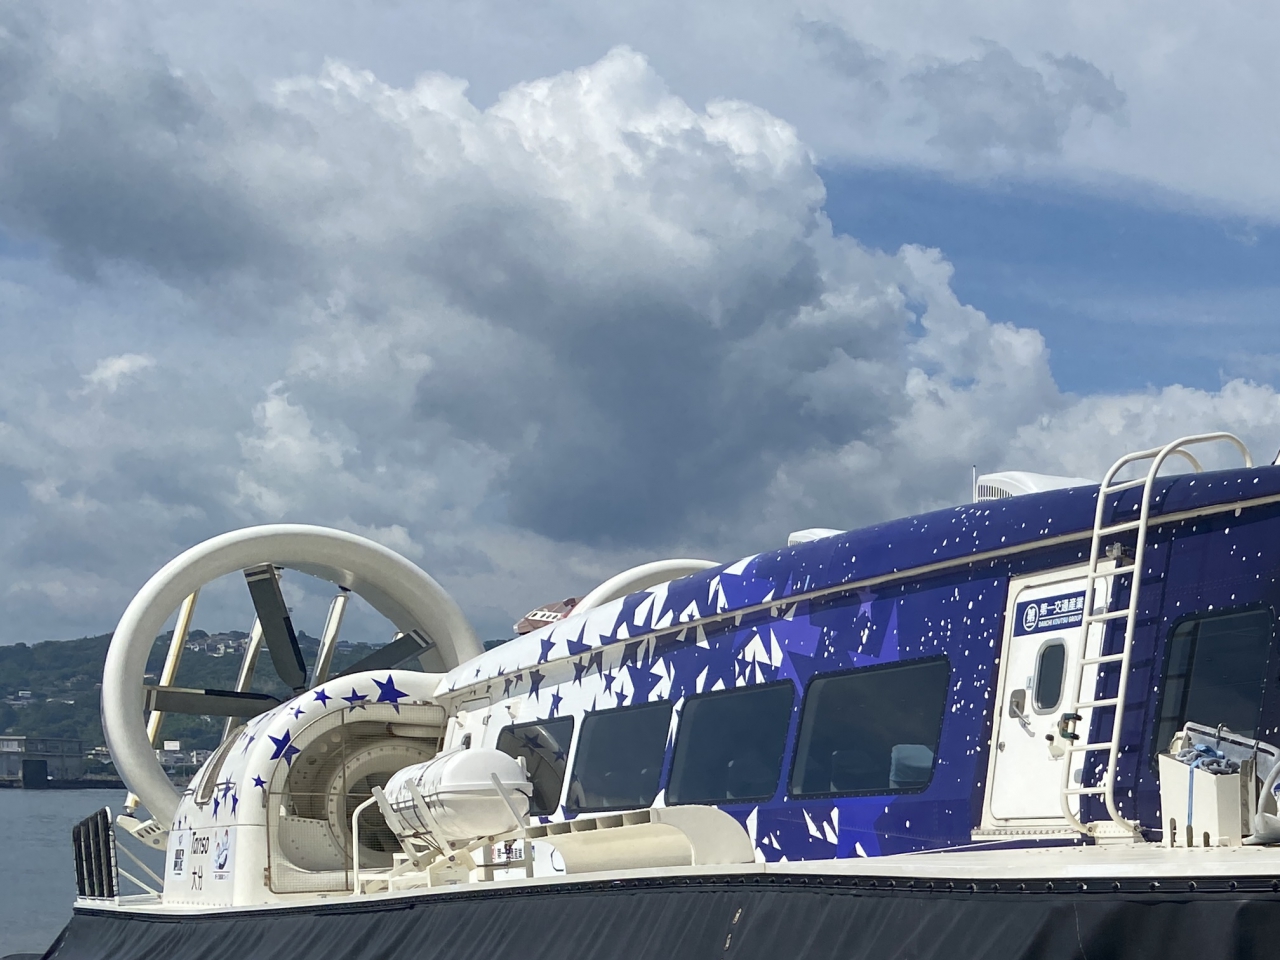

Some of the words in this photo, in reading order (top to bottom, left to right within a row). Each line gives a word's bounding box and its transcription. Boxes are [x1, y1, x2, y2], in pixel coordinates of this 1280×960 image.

[1040, 596, 1084, 616] 第一交通産業
[1068, 614, 1082, 623] GROUP
[190, 831, 210, 855] Tanso
[191, 865, 203, 891] 大分
